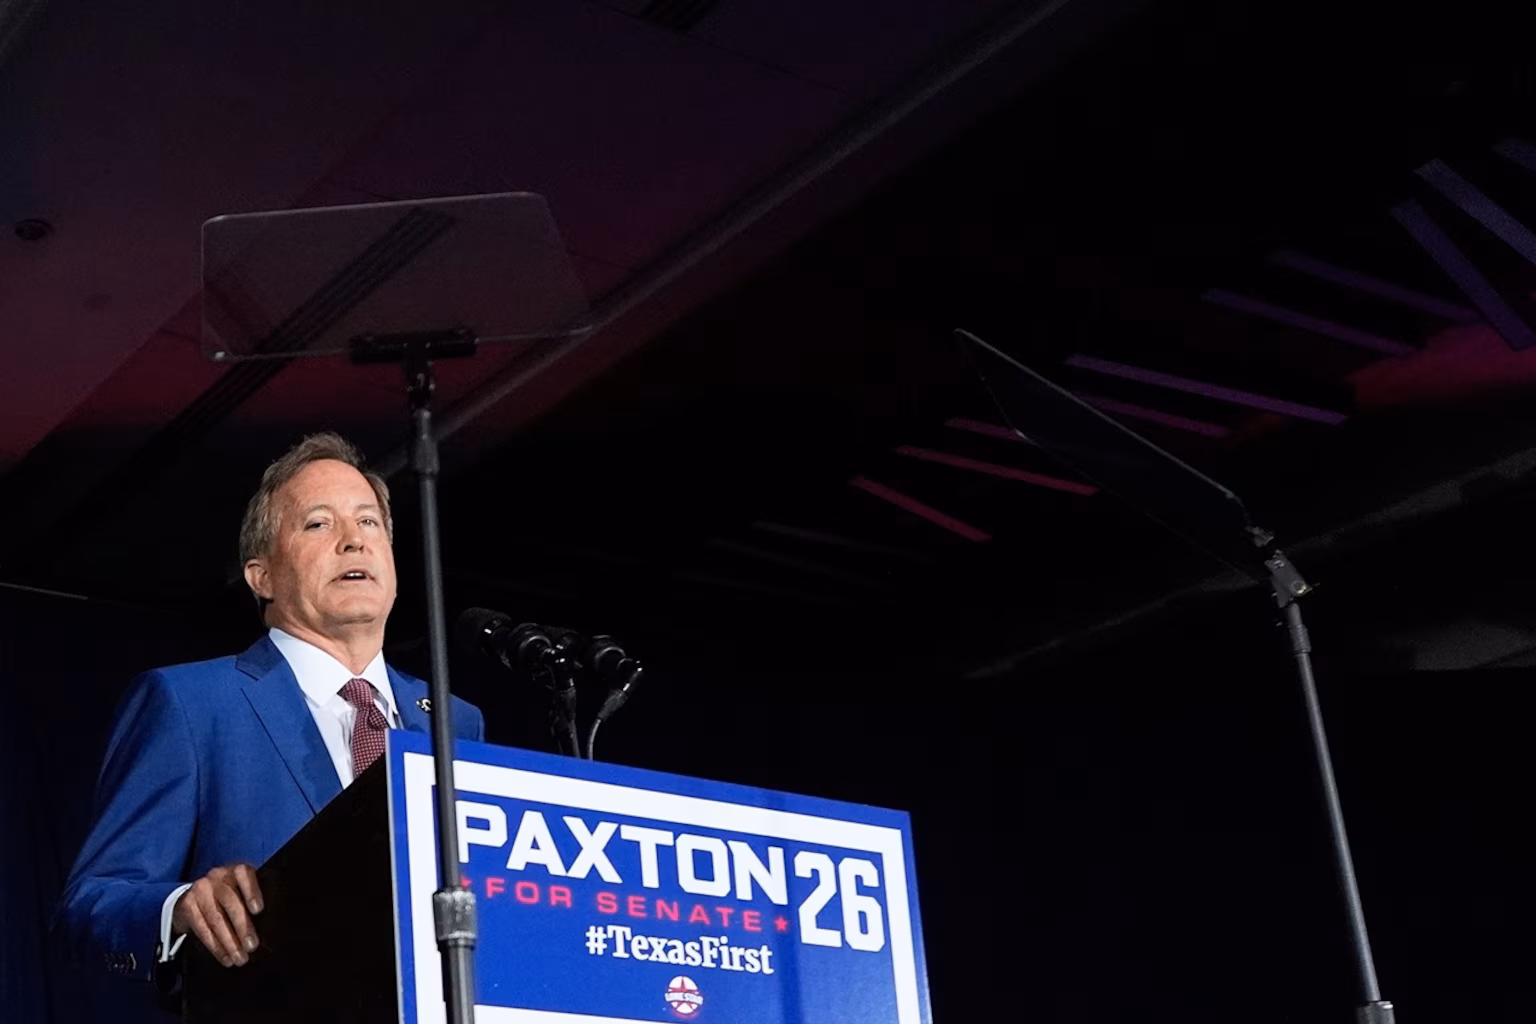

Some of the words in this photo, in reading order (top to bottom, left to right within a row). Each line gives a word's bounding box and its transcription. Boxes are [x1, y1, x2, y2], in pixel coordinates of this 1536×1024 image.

[454, 800, 789, 905] PAXTON
[794, 851, 886, 952] 26
[486, 877, 572, 908] FOR
[597, 891, 763, 933] SENATE
[585, 925, 775, 975] #TexasFirst
